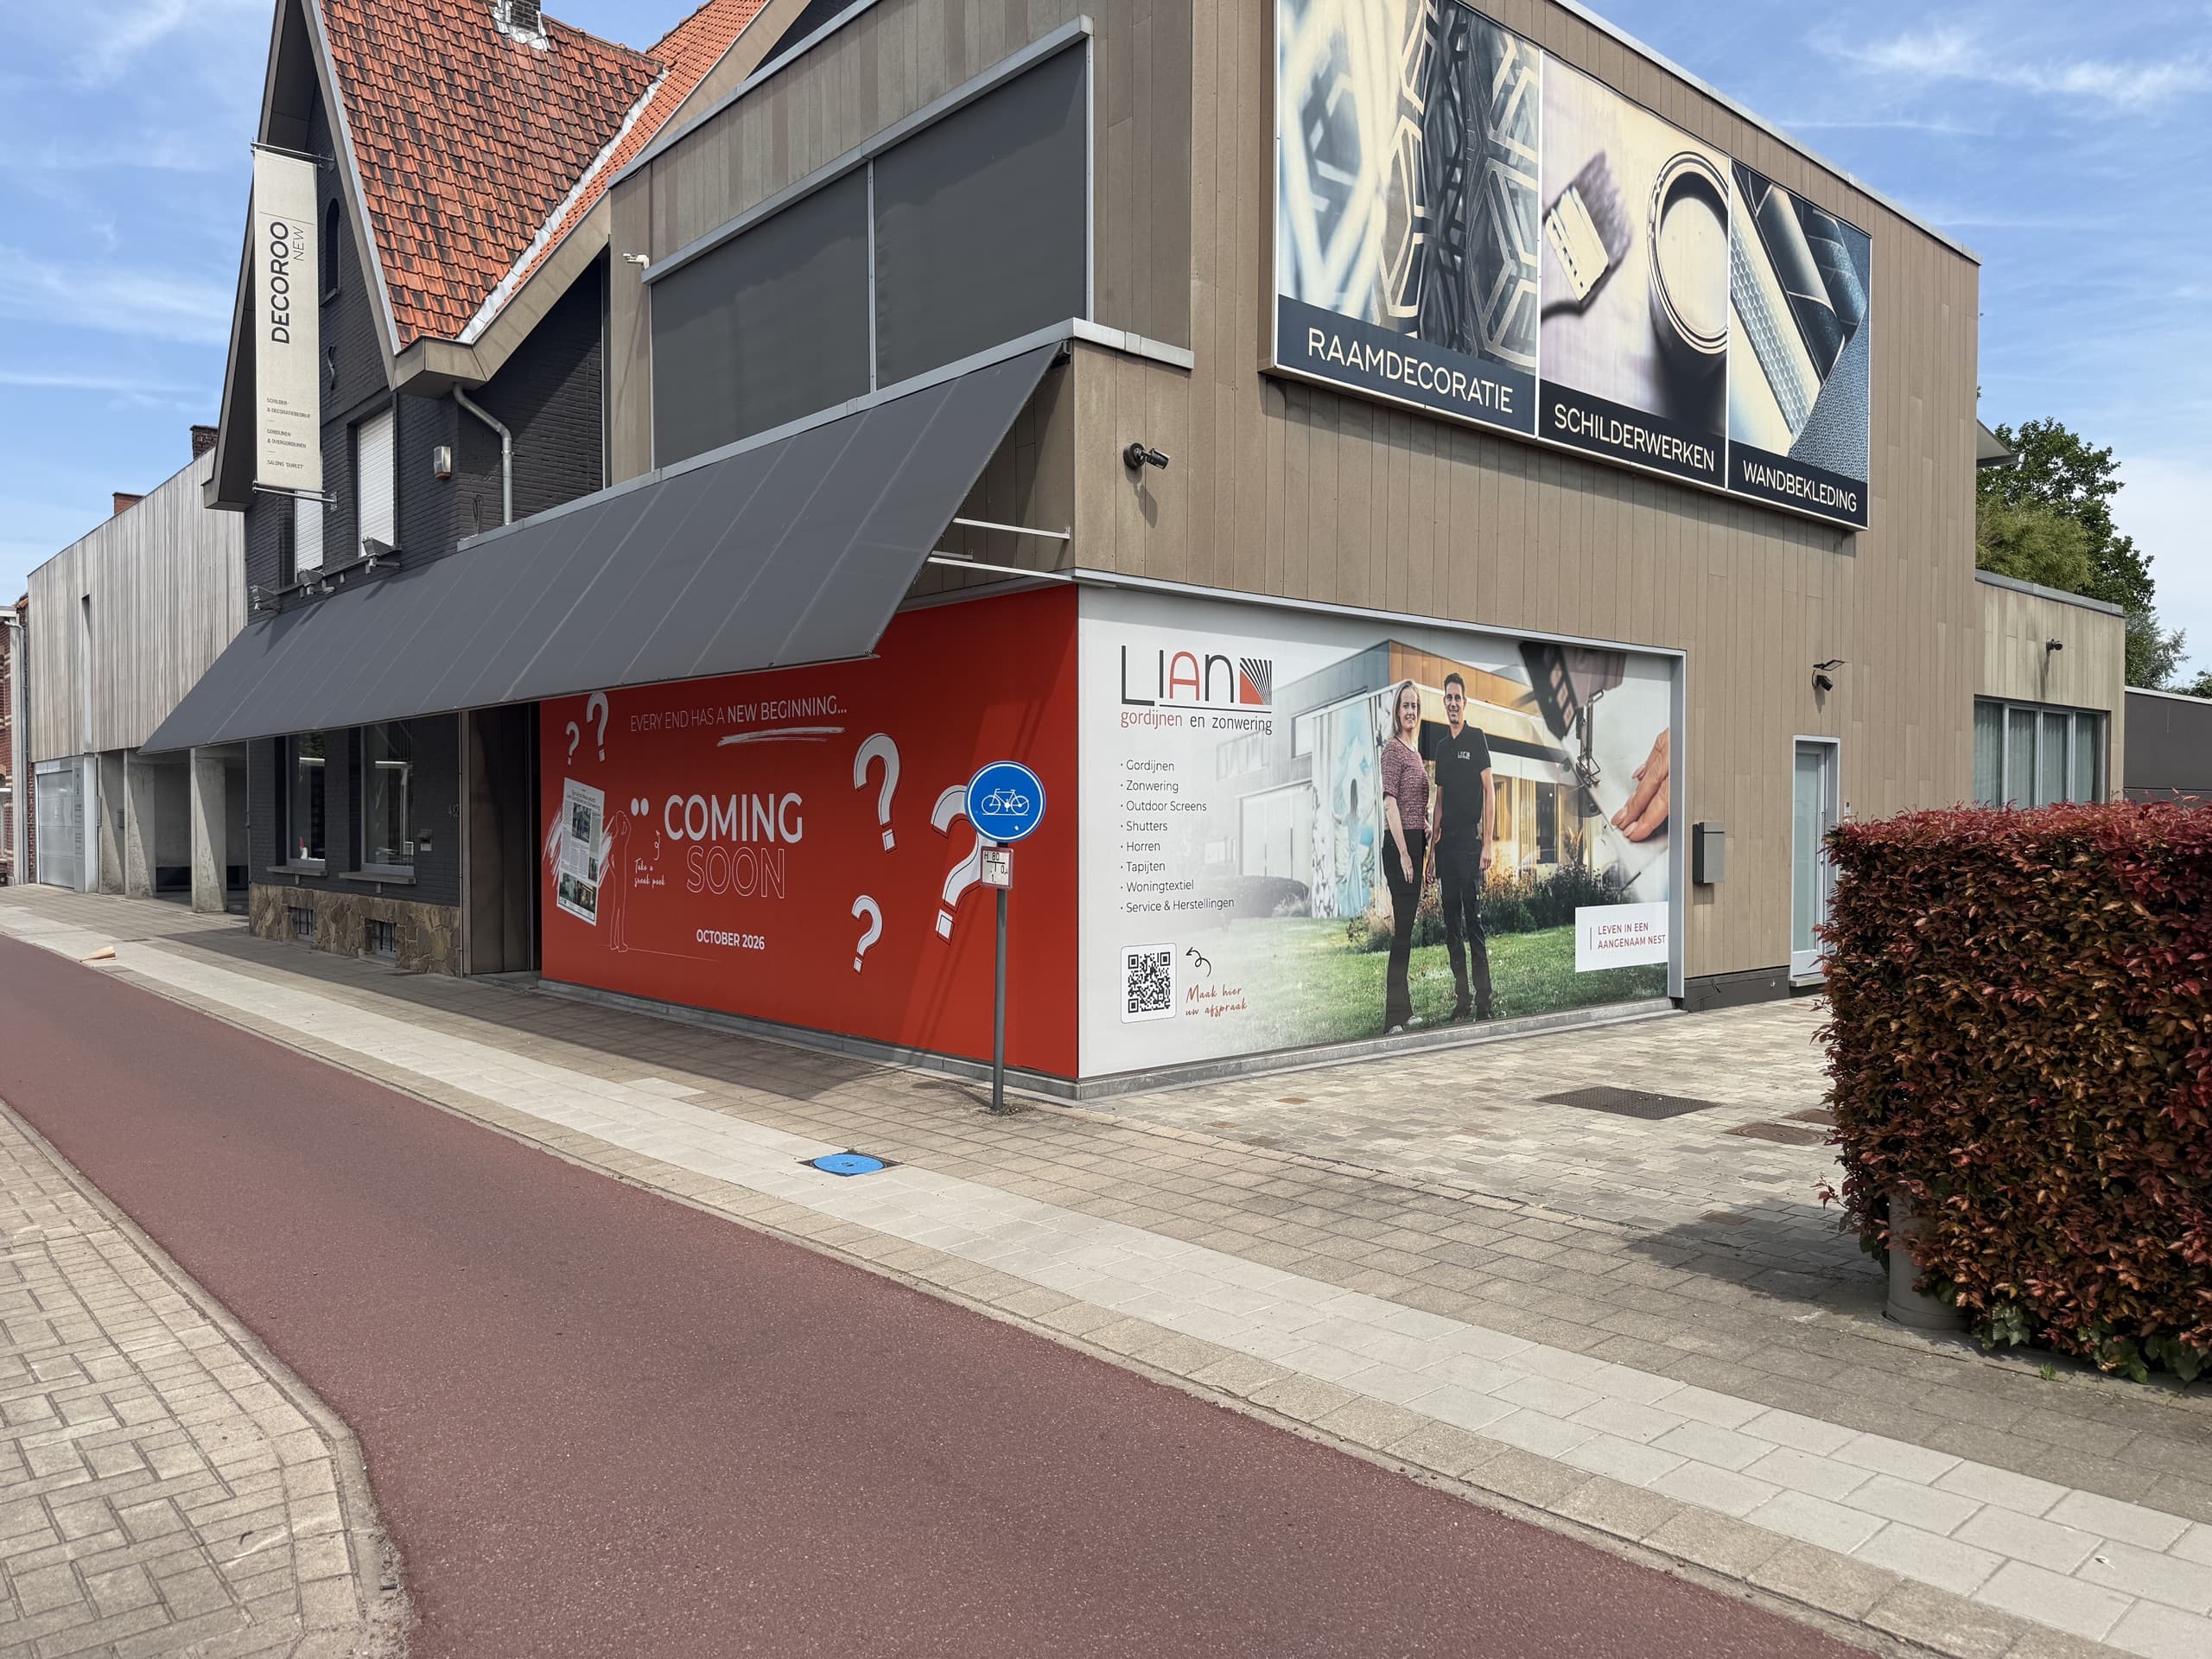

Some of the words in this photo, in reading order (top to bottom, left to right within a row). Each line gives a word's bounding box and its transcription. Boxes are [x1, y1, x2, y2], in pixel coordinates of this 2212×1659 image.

[292, 226, 304, 262] NEW
[270, 221, 290, 344] DECOROO
[1307, 327, 1514, 414] RAAMDECORATIE
[1554, 403, 1714, 472] SCHILDERWERKEN
[1742, 459, 1858, 512] WANDBEKLEDING
[630, 713, 664, 732] EVERY
[664, 710, 690, 729] END
[691, 707, 715, 727] HAS
[716, 707, 726, 724] A
[727, 702, 758, 723] NEW
[760, 695, 848, 721] BEGINNING...
[1121, 709, 1183, 729] gordijnen
[1190, 715, 1205, 728] en
[1211, 715, 1273, 735] zonwering
[1126, 760, 1175, 773] Gordijnen
[1126, 779, 1179, 794] Zonwering
[1126, 800, 1168, 811] Outdoor
[1170, 800, 1207, 811] Screens
[664, 792, 803, 843] COMING
[1126, 820, 1168, 831] Shutters
[1126, 841, 1160, 852] Horren
[984, 851, 989, 860] H
[992, 852, 1000, 861] 80
[634, 857, 648, 874] Take
[686, 845, 785, 899] SOON
[1126, 861, 1166, 874] Tapijten
[1126, 879, 1194, 894] Woningtextiel
[1126, 900, 1162, 913] Service
[1164, 899, 1171, 911] &
[1173, 898, 1235, 911] Herstellingen
[1598, 925, 1622, 935] LEVEN
[1624, 924, 1632, 933] IN
[1634, 922, 1649, 932] EEN
[696, 929, 740, 947] OCTOBER
[742, 934, 766, 950] 2026
[1598, 936, 1646, 950] AANGENAAM
[1648, 934, 1666, 944] NEST
[1185, 983, 1217, 1002] Maak
[1223, 983, 1243, 996] hier
[1205, 996, 1248, 1018] afspraak
